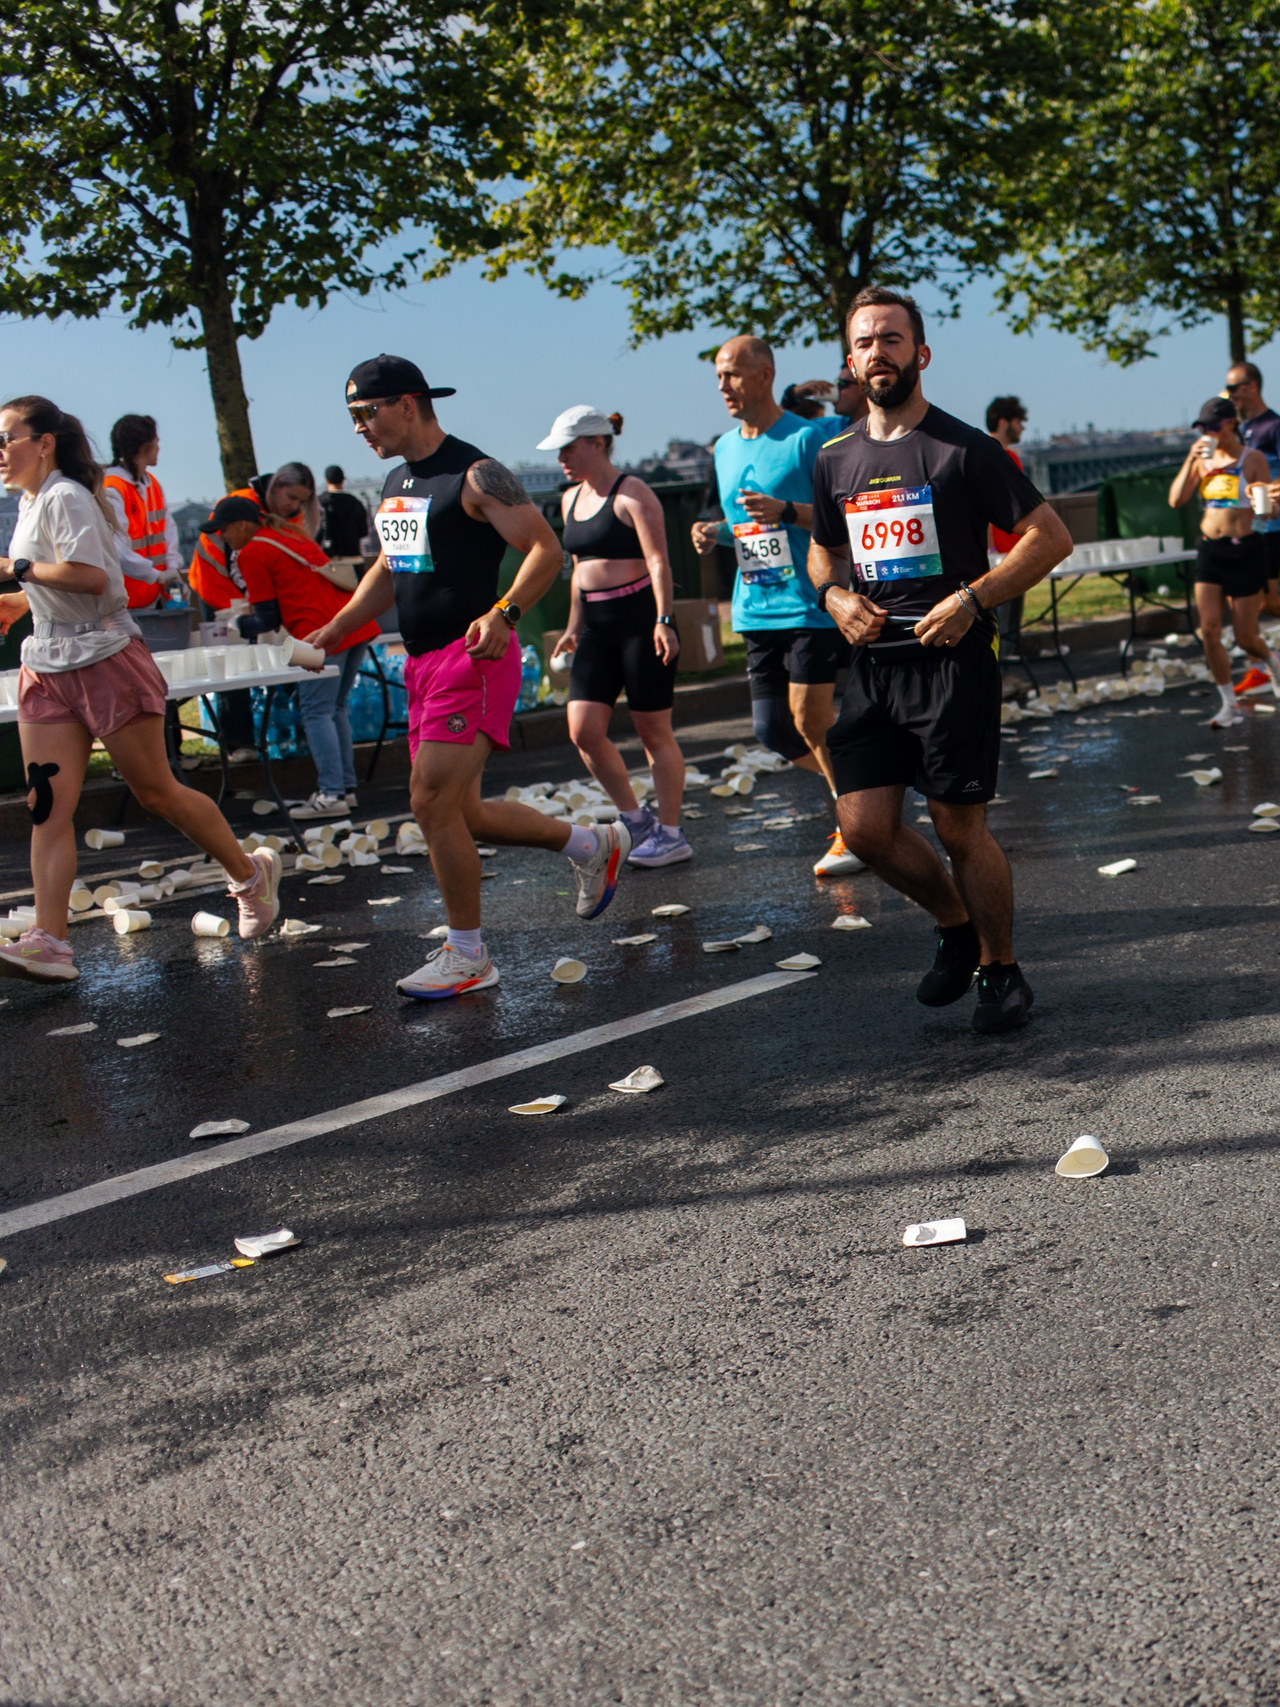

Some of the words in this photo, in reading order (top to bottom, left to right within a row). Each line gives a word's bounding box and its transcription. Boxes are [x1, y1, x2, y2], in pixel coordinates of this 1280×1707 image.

[906, 492, 920, 501] KM
[381, 519, 419, 542] 5399
[861, 518, 925, 550] 6998
[741, 538, 782, 560] 5458
[865, 564, 875, 578] E
